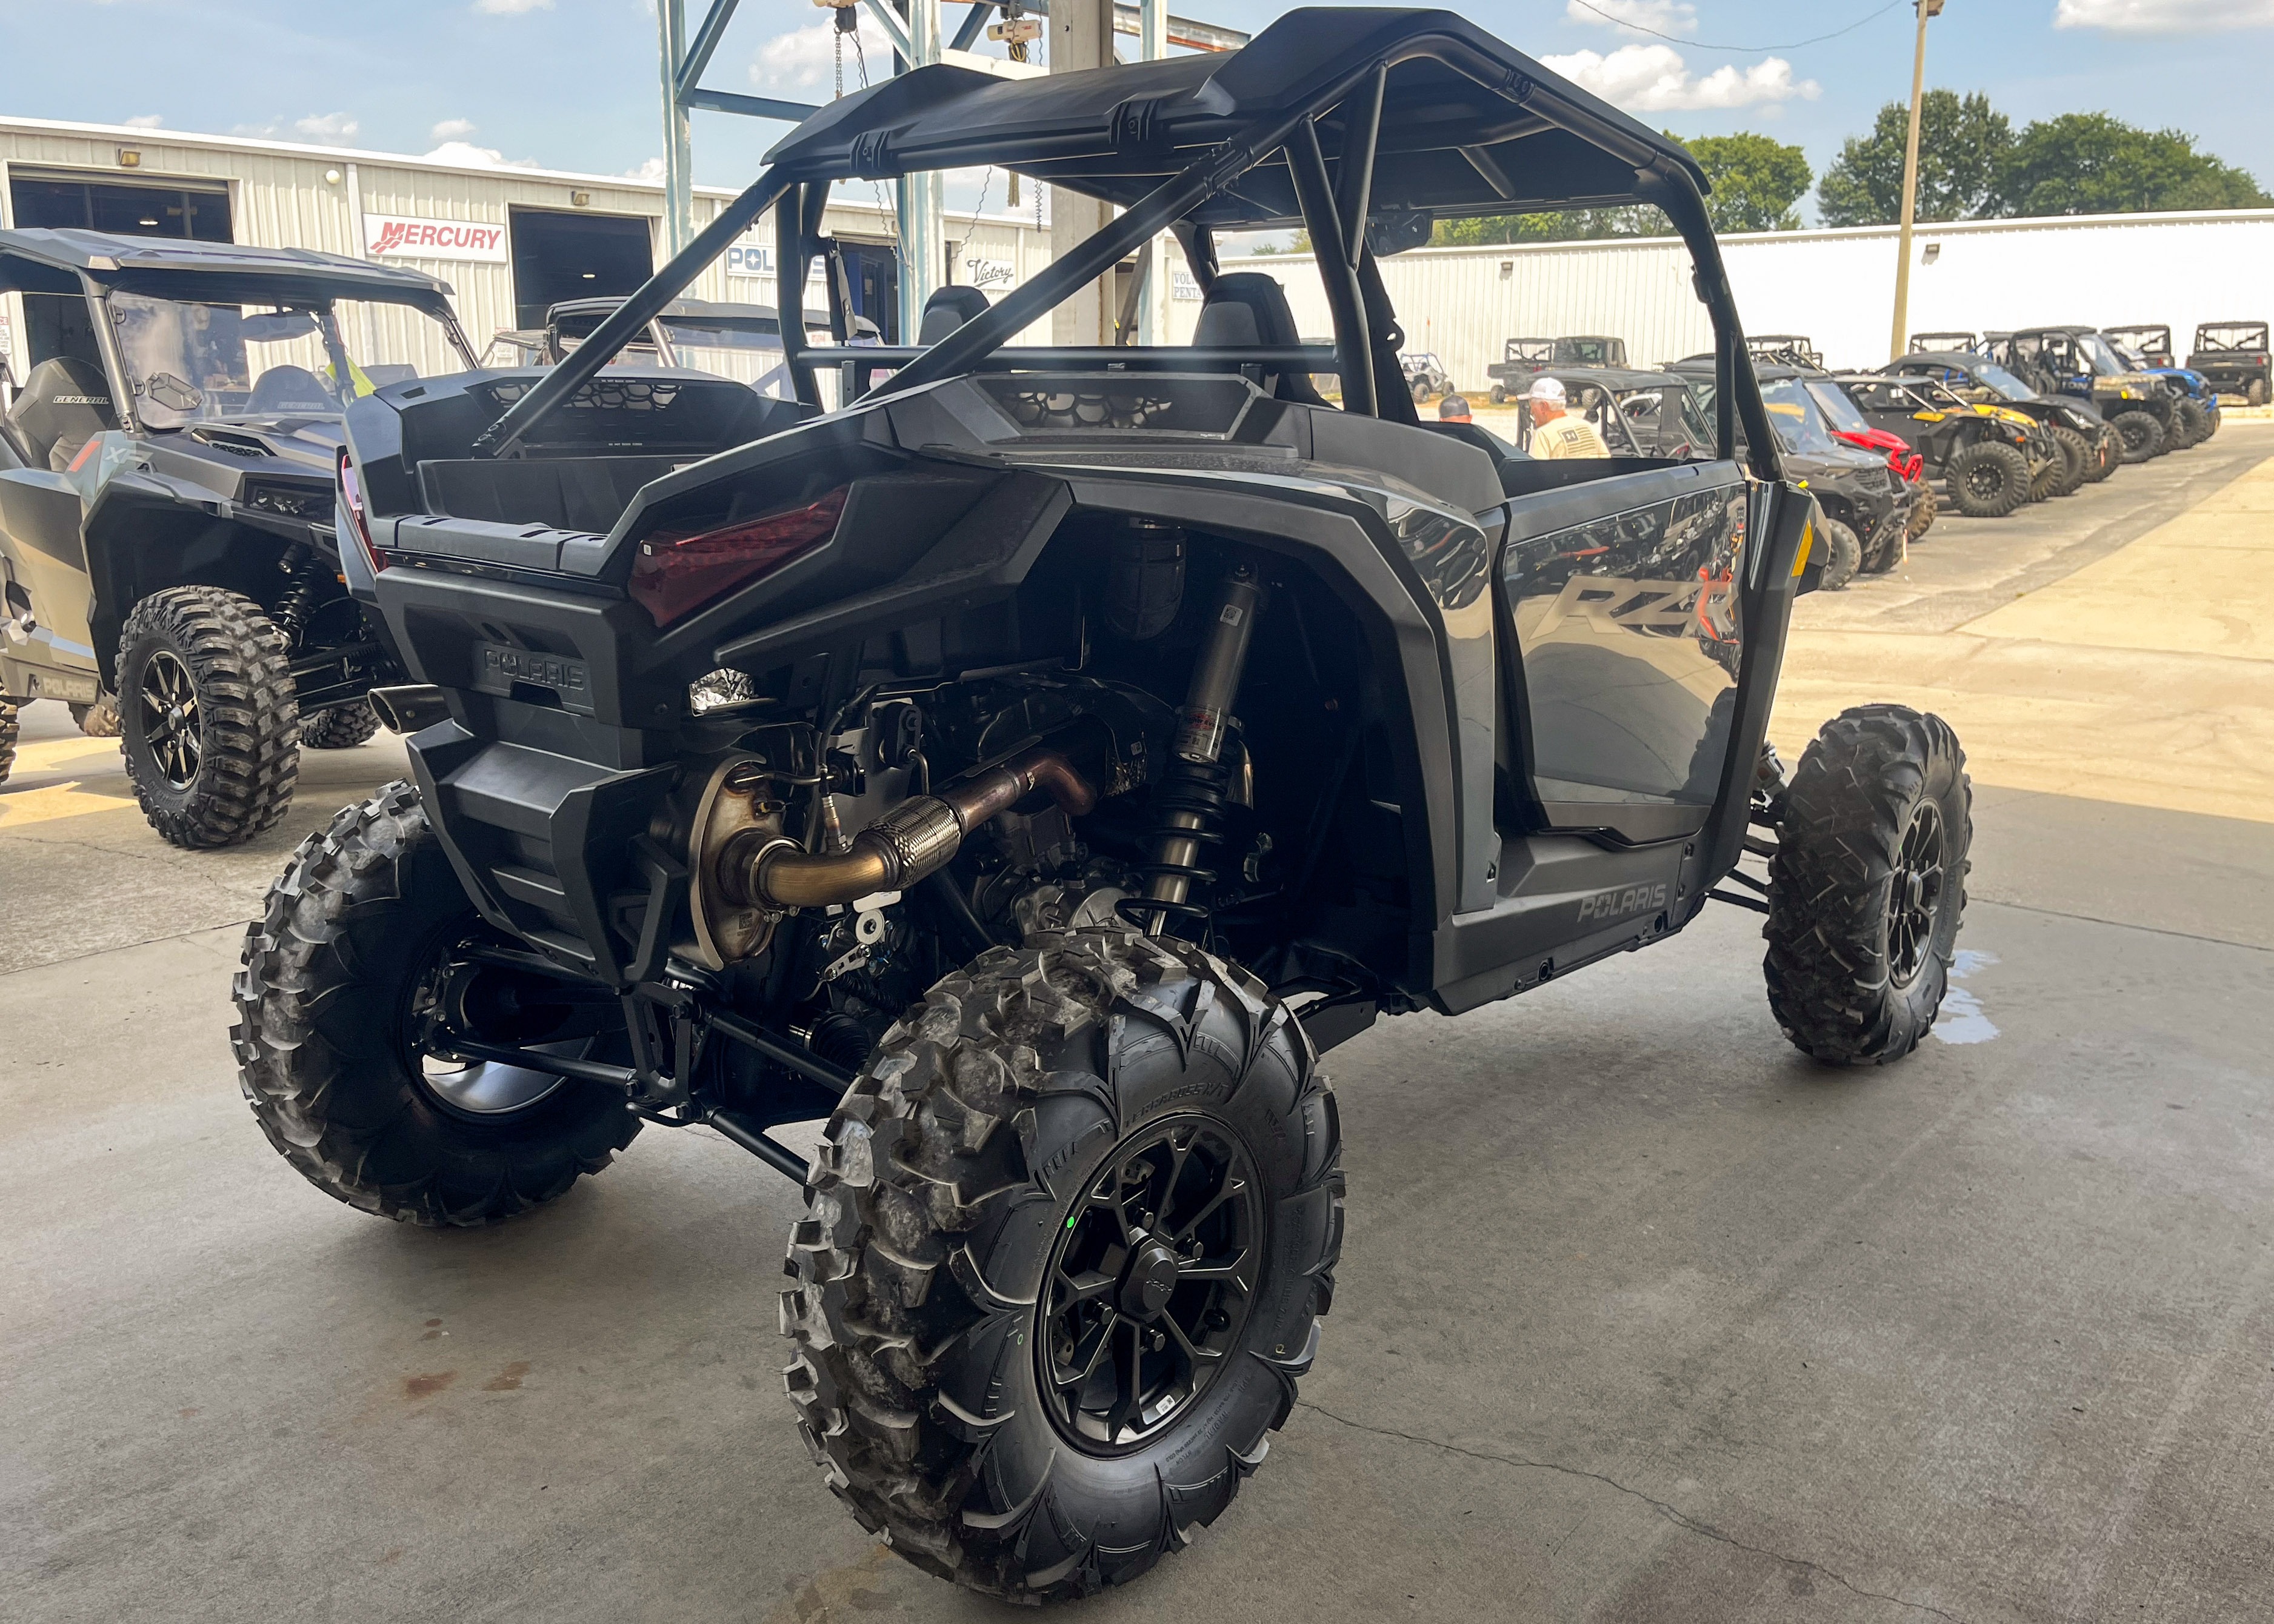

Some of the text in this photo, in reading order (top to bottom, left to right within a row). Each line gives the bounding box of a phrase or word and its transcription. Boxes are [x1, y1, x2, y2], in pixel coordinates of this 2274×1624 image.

[370, 222, 502, 254] MERCURY
[967, 259, 1014, 288] Victory
[53, 396, 109, 404] GENERAL
[1527, 575, 1739, 641] RZR
[485, 649, 585, 691] POLARIS
[42, 677, 95, 698] POLARIS
[1577, 884, 1667, 923] POLARIS
